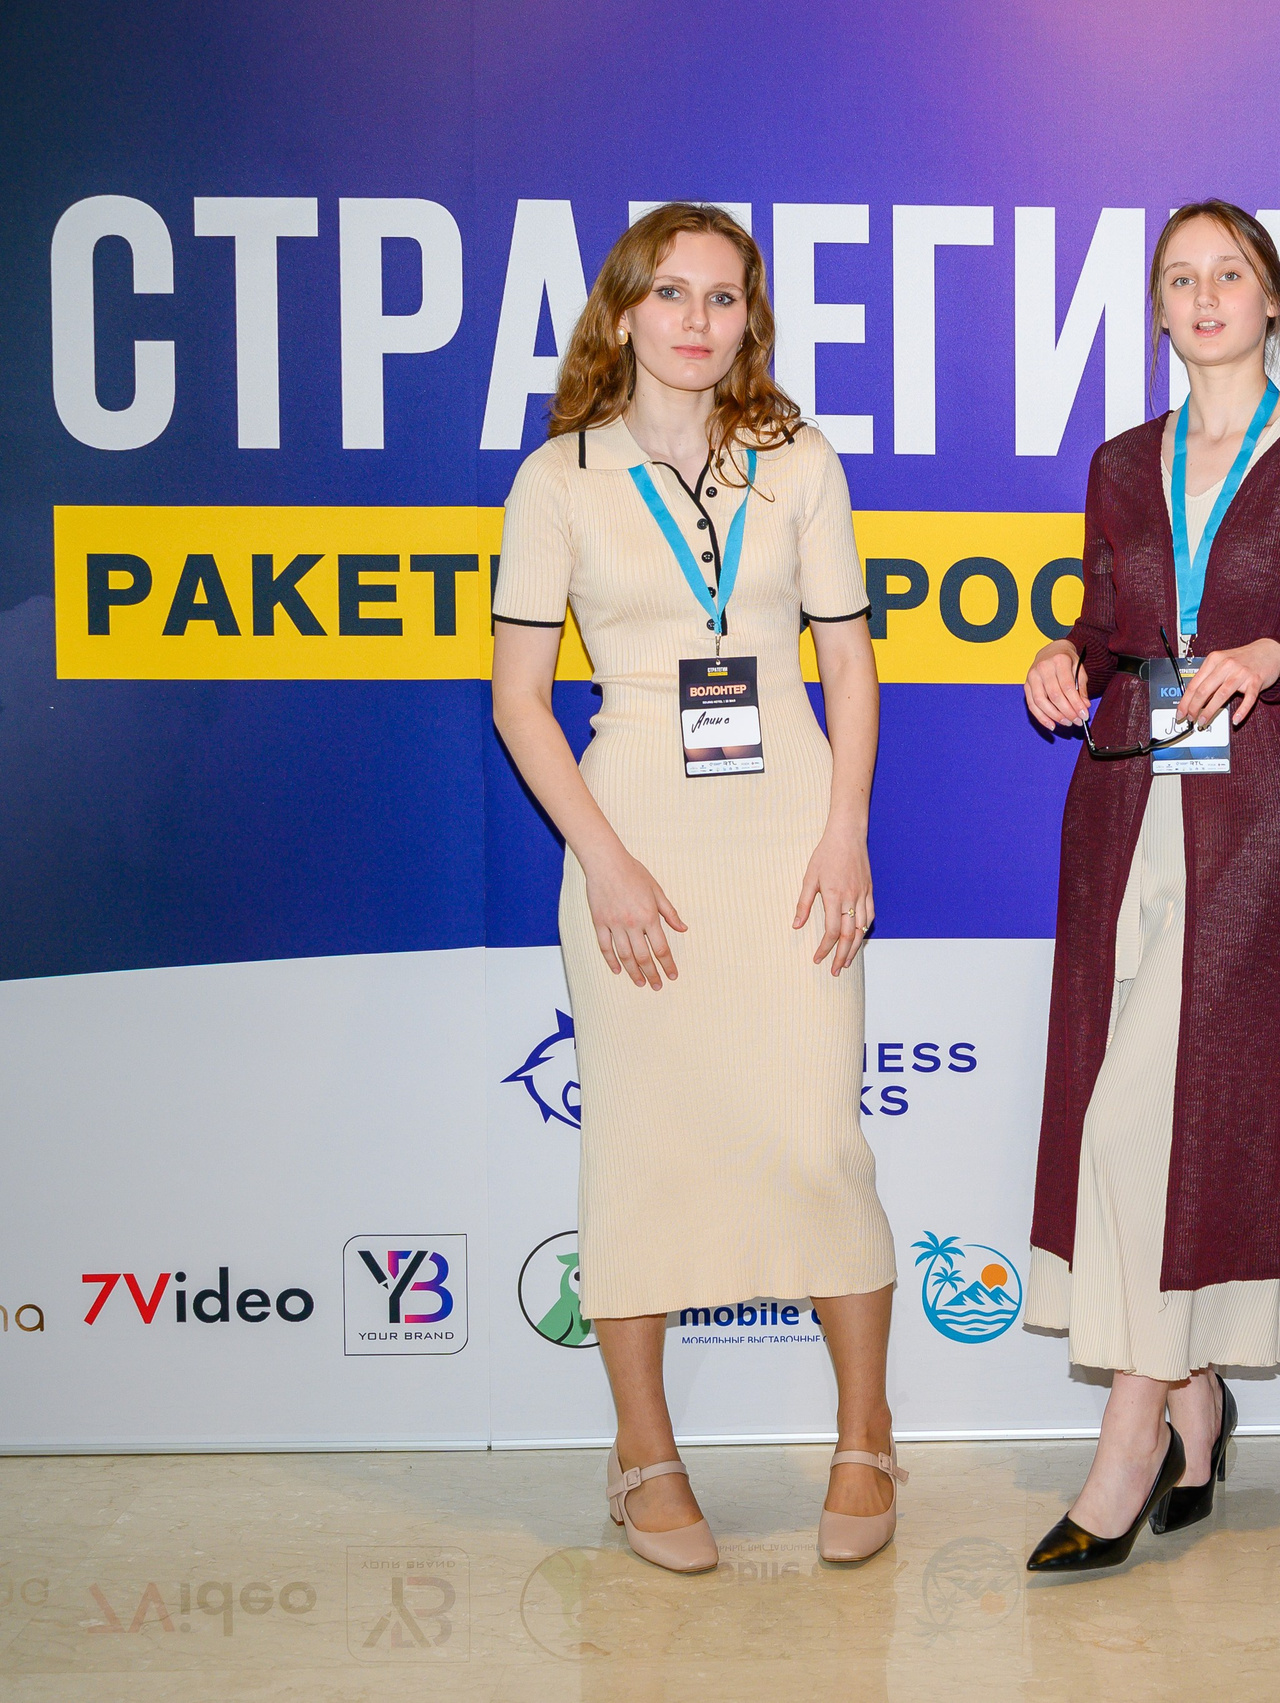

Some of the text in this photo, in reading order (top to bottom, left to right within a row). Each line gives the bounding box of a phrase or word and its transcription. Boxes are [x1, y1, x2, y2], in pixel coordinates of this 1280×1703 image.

[86, 552, 502, 638] РАКЕТ
[689, 684, 747, 697] ВОЛОНТЕР
[82, 1267, 314, 1325] 7Video
[680, 1302, 799, 1327] mobile
[359, 1331, 454, 1341] YOUR BRAND
